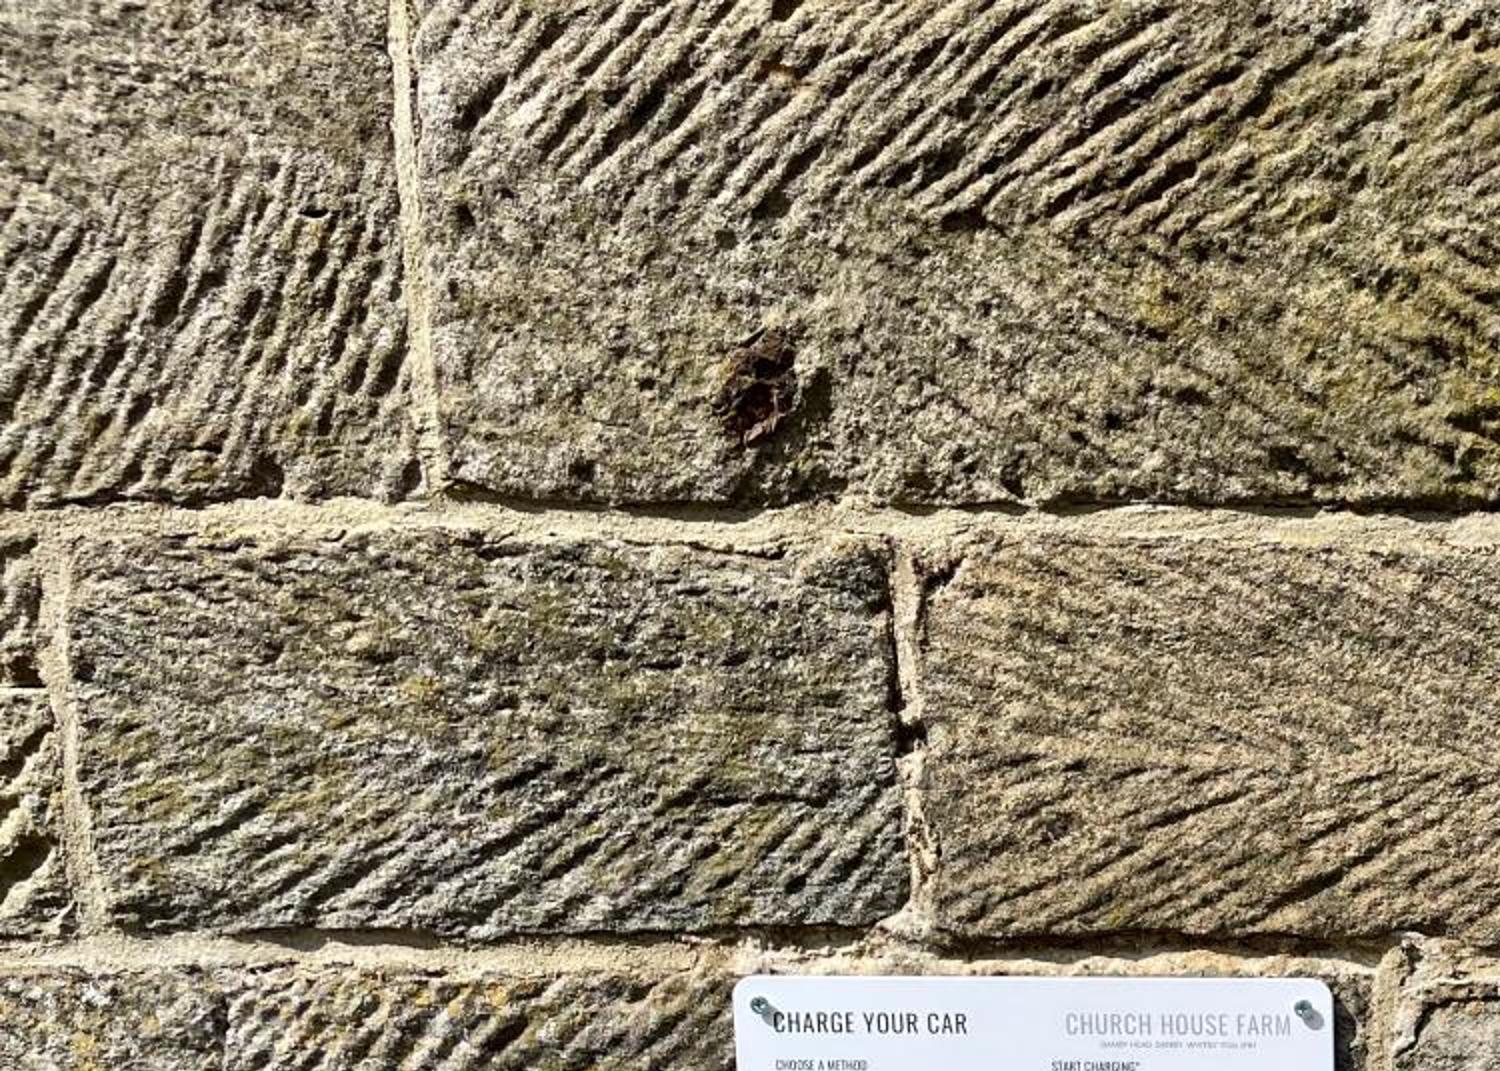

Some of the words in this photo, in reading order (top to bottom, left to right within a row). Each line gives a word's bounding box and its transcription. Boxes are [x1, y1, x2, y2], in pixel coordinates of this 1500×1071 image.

[773, 1011, 853, 1033] CHARGE
[864, 1012, 918, 1034] YOUR
[927, 1013, 967, 1034] CAR
[1066, 1013, 1151, 1036] CHURCH
[1162, 1014, 1228, 1036] HOUSE
[1237, 1014, 1290, 1036] FARM
[776, 1059, 814, 1071] CHOOSE
[818, 1060, 825, 1071] A
[828, 1060, 867, 1071] METHOD
[1051, 1061, 1081, 1071] START
